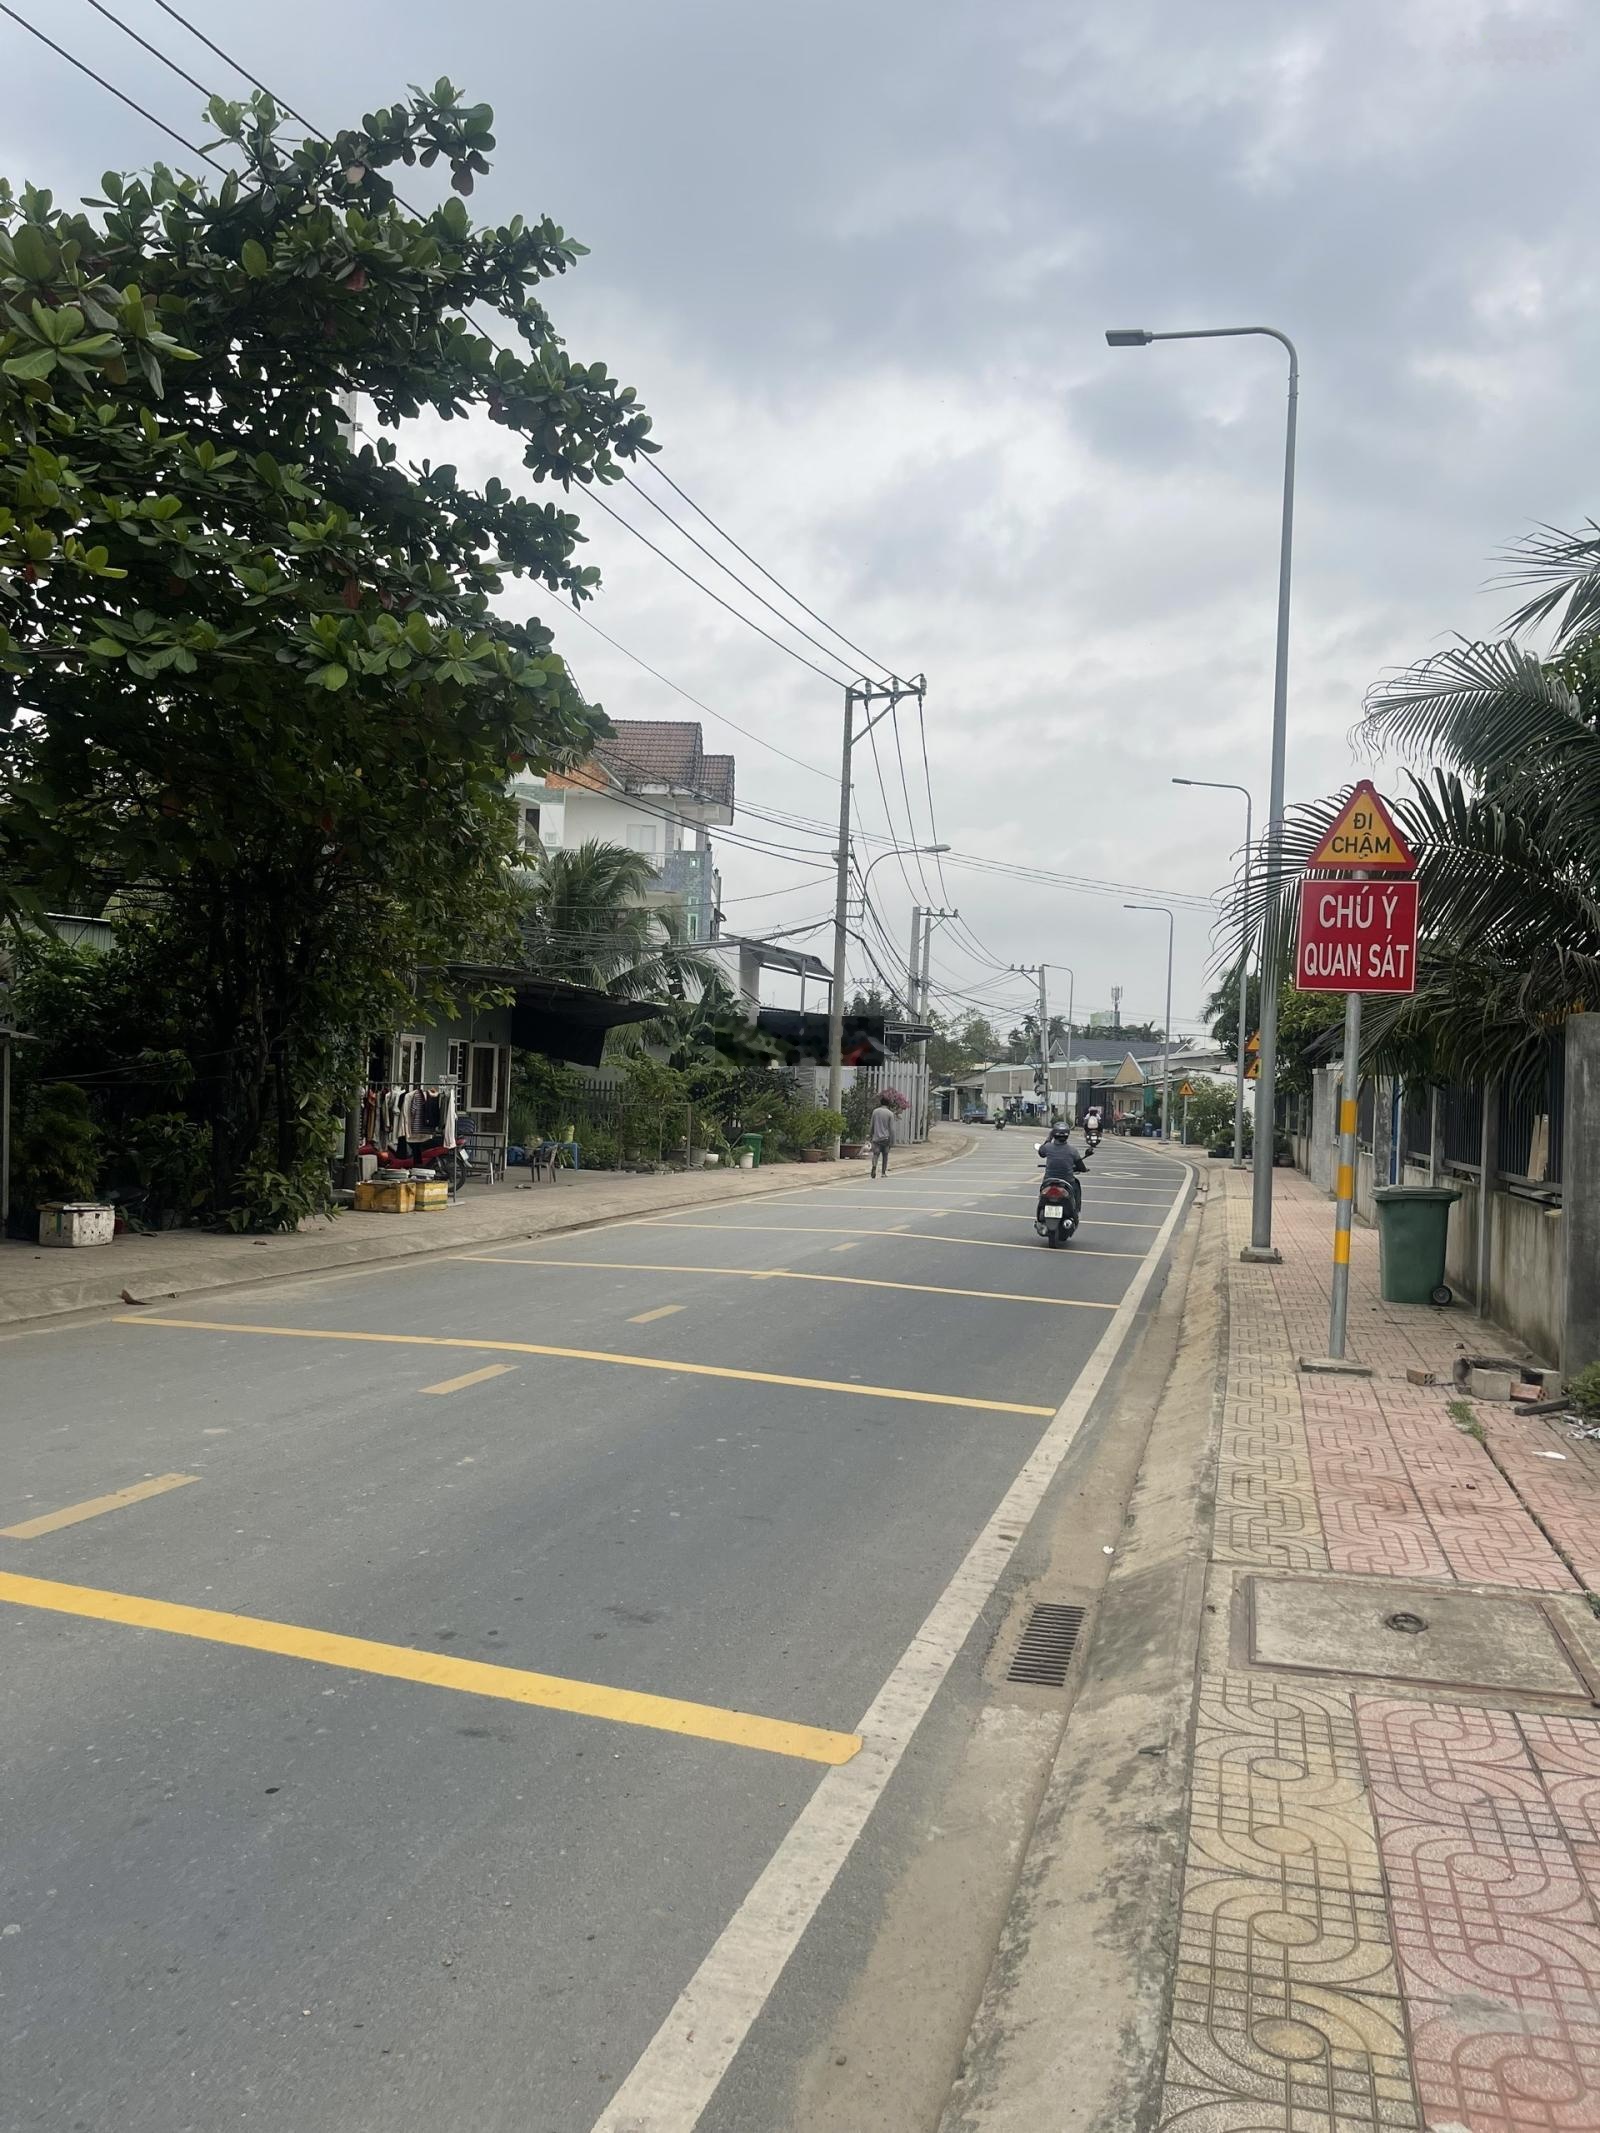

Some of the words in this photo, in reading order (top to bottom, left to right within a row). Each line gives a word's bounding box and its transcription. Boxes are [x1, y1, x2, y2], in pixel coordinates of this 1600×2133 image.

[1353, 812, 1373, 830] ĐI
[1331, 832, 1391, 857] CHẬM
[1319, 885, 1374, 929] CHÚ
[1381, 885, 1399, 929] Ý
[1304, 942, 1362, 977] QUAN
[1367, 934, 1410, 979] SÁT
